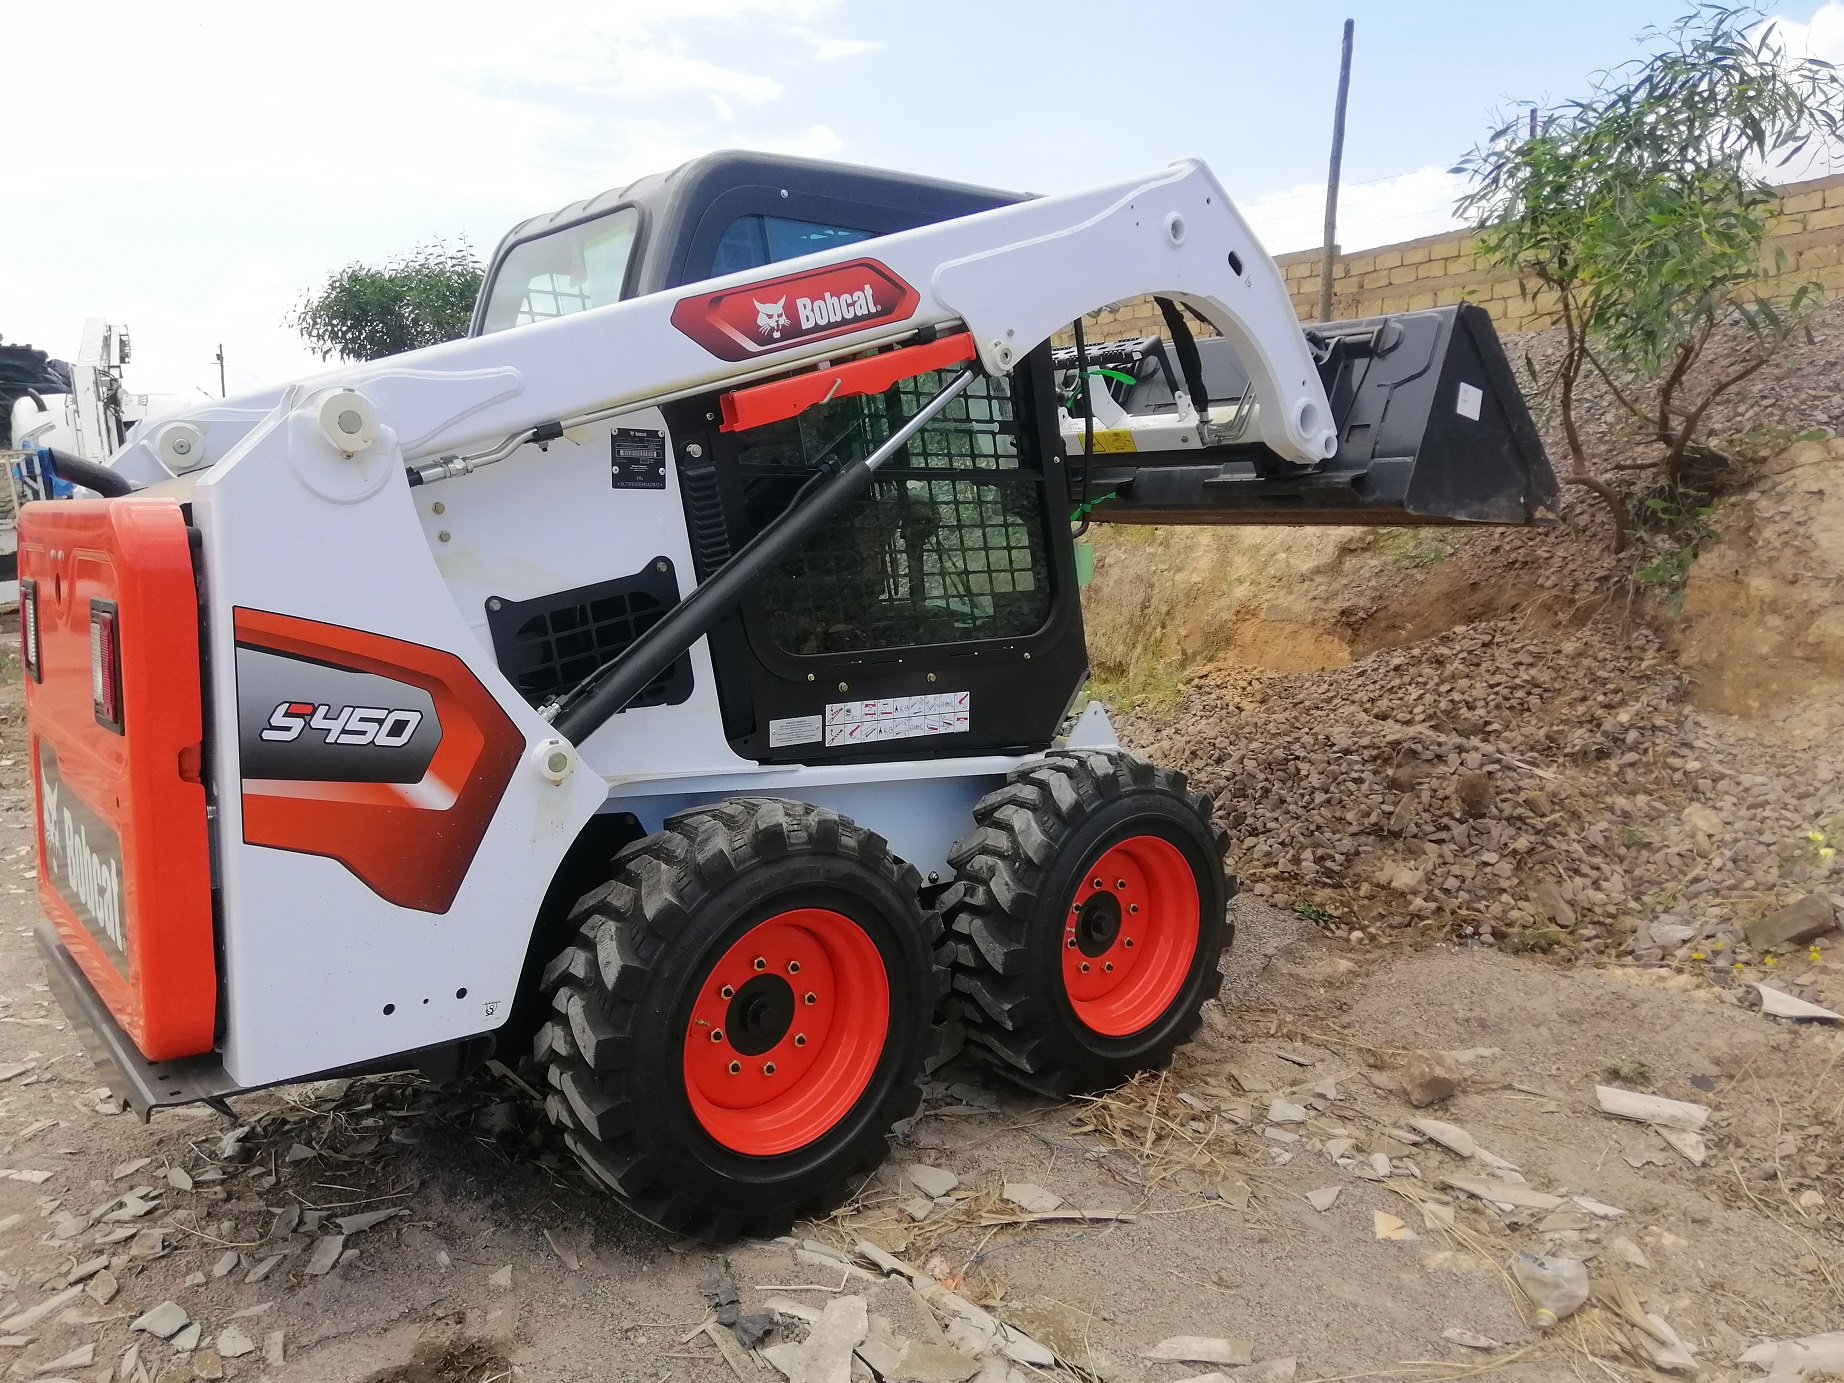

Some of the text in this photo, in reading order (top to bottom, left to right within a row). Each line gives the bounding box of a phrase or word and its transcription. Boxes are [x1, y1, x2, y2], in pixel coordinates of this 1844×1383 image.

[796, 284, 876, 329] Bobcat
[259, 701, 423, 746] S450
[63, 806, 122, 951] Bobcat
